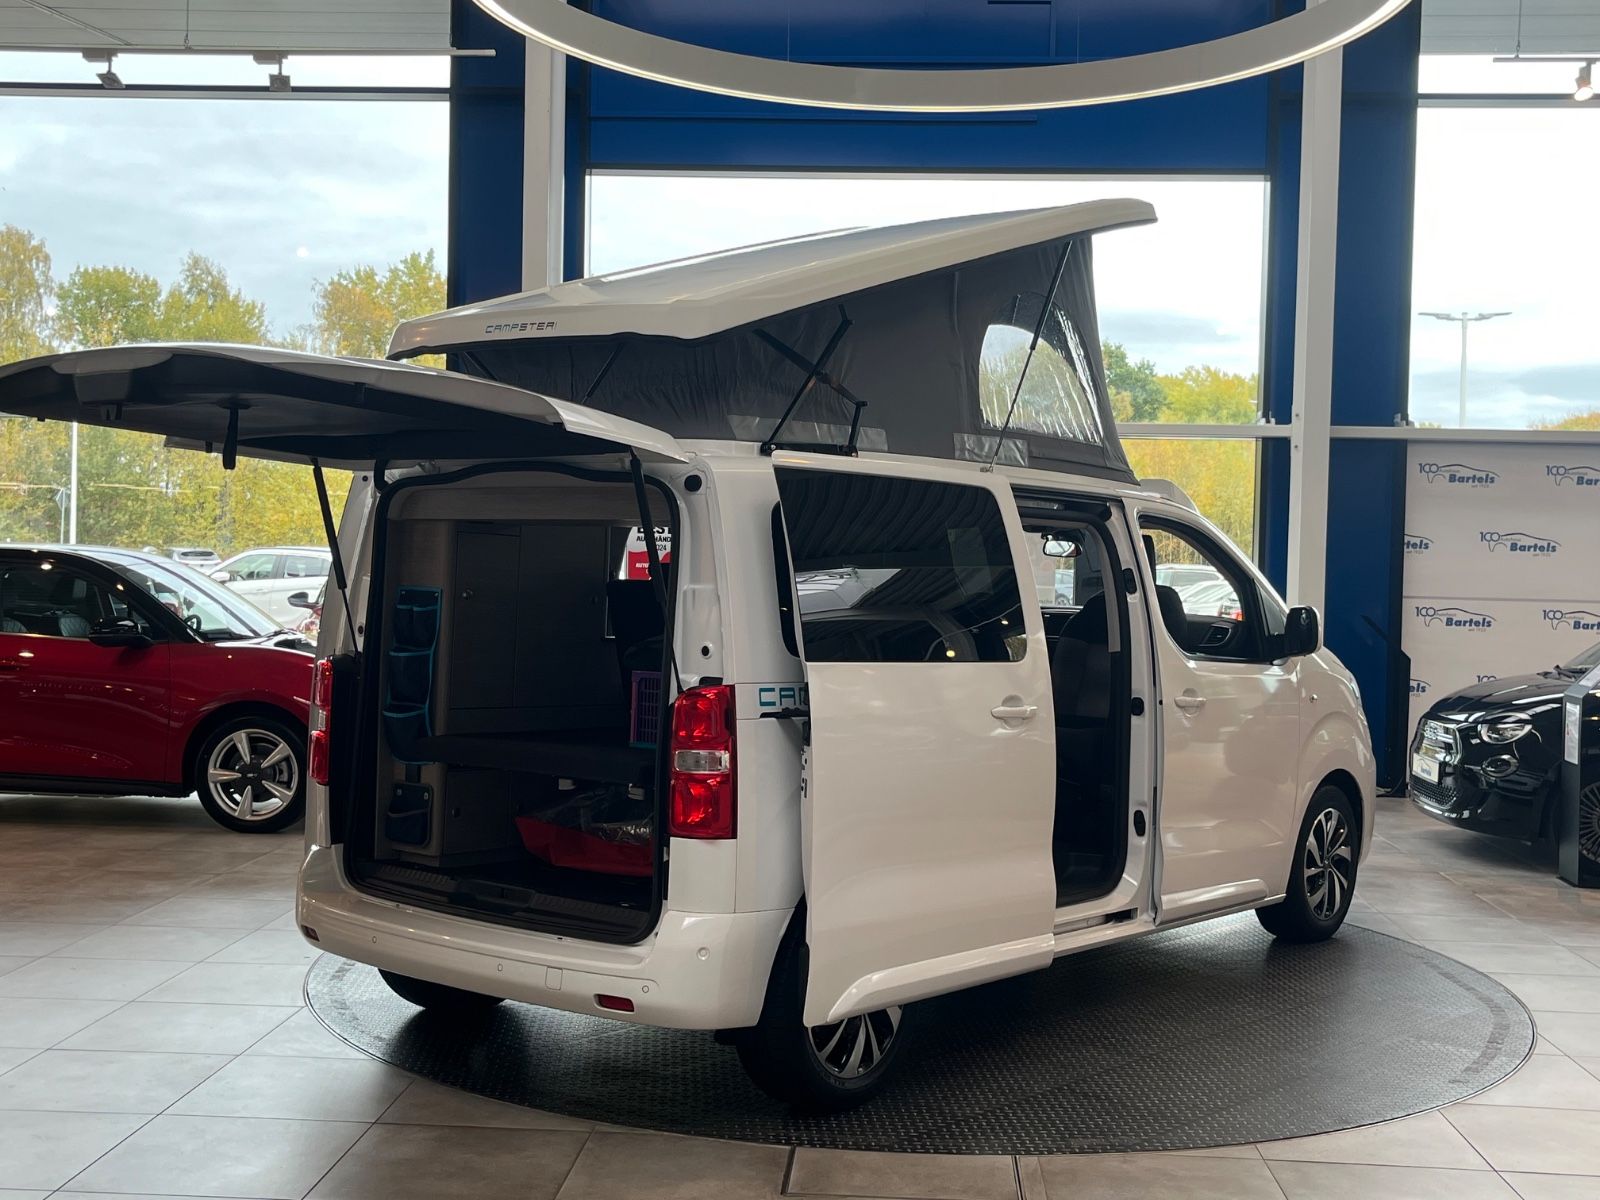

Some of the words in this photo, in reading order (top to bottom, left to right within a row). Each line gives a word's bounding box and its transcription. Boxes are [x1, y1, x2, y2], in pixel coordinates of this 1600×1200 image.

[1418, 463, 1439, 474] 100
[1546, 465, 1567, 476] 100
[1448, 473, 1495, 484] Bartels
[1576, 476, 1600, 486] Bar
[1479, 531, 1501, 542] 100
[1404, 539, 1430, 550] tels
[1509, 542, 1557, 553] Bartels
[1415, 606, 1436, 617] 100
[1543, 609, 1564, 620] 100
[1445, 617, 1492, 628] Bartels
[1573, 620, 1600, 630] Bart
[1409, 682, 1426, 693] els
